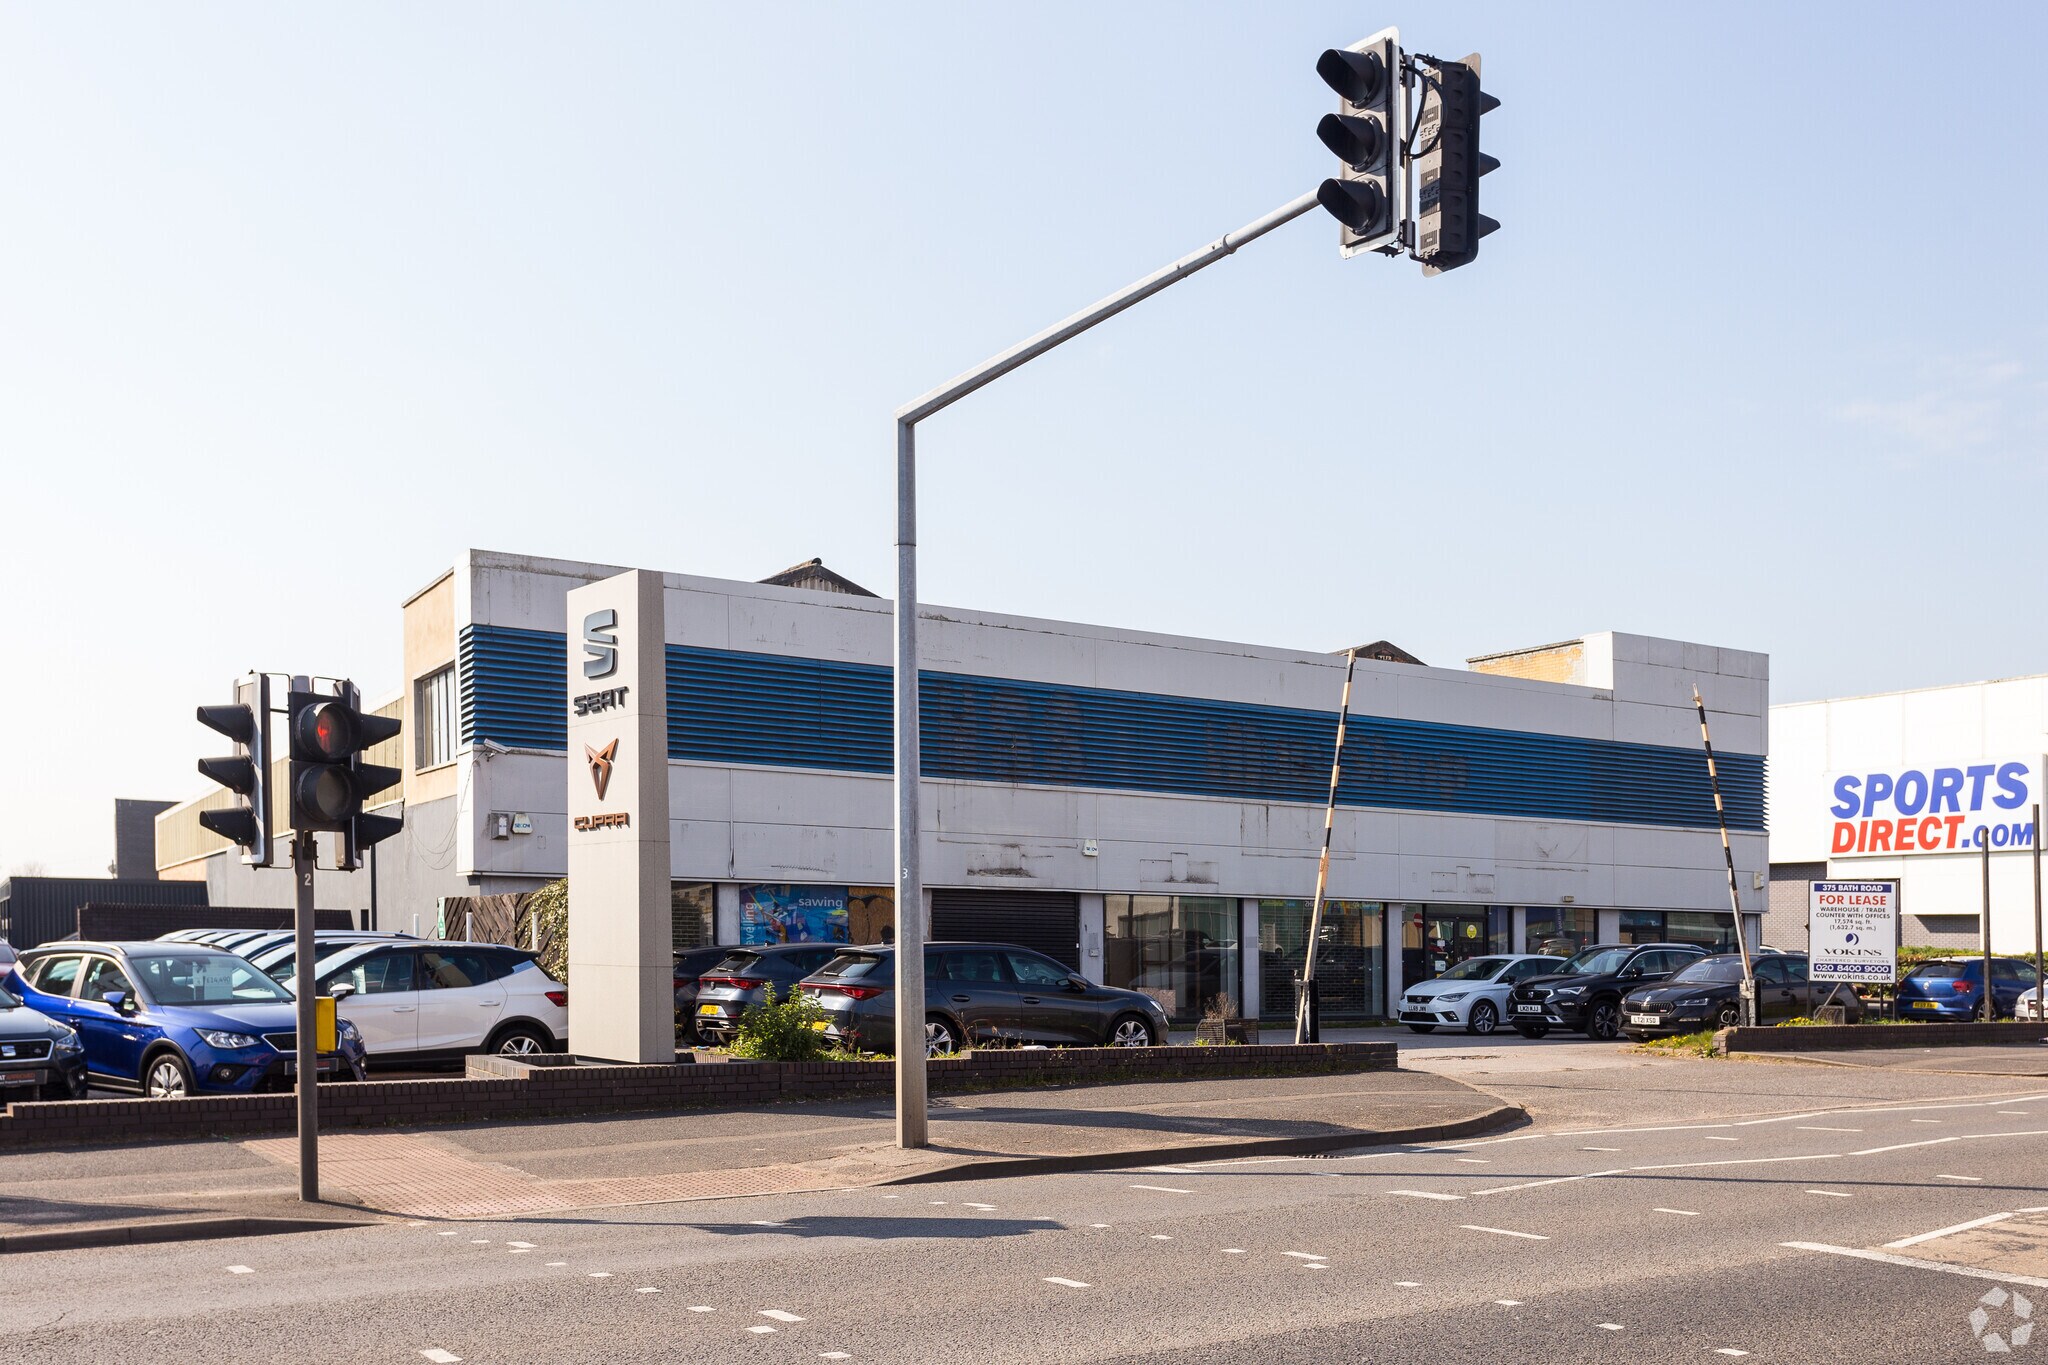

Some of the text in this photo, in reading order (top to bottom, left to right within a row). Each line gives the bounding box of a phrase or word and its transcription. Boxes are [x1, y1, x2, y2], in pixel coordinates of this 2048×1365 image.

[574, 686, 629, 715] SEAT
[1830, 761, 2030, 819] SPORTS
[574, 812, 630, 832] CUPRA
[1831, 815, 2033, 854] DIRECT.COM
[902, 867, 908, 879] 3
[304, 873, 312, 886] 2
[1822, 884, 1836, 892] 375
[1838, 884, 1859, 892] BATH
[798, 896, 843, 910] sawing
[1819, 895, 1887, 906] FOR LEASE
[1824, 948, 1882, 956] VOKINS
[1815, 964, 1834, 972] 020
[1813, 973, 1892, 981] www.vokins.co.uk
